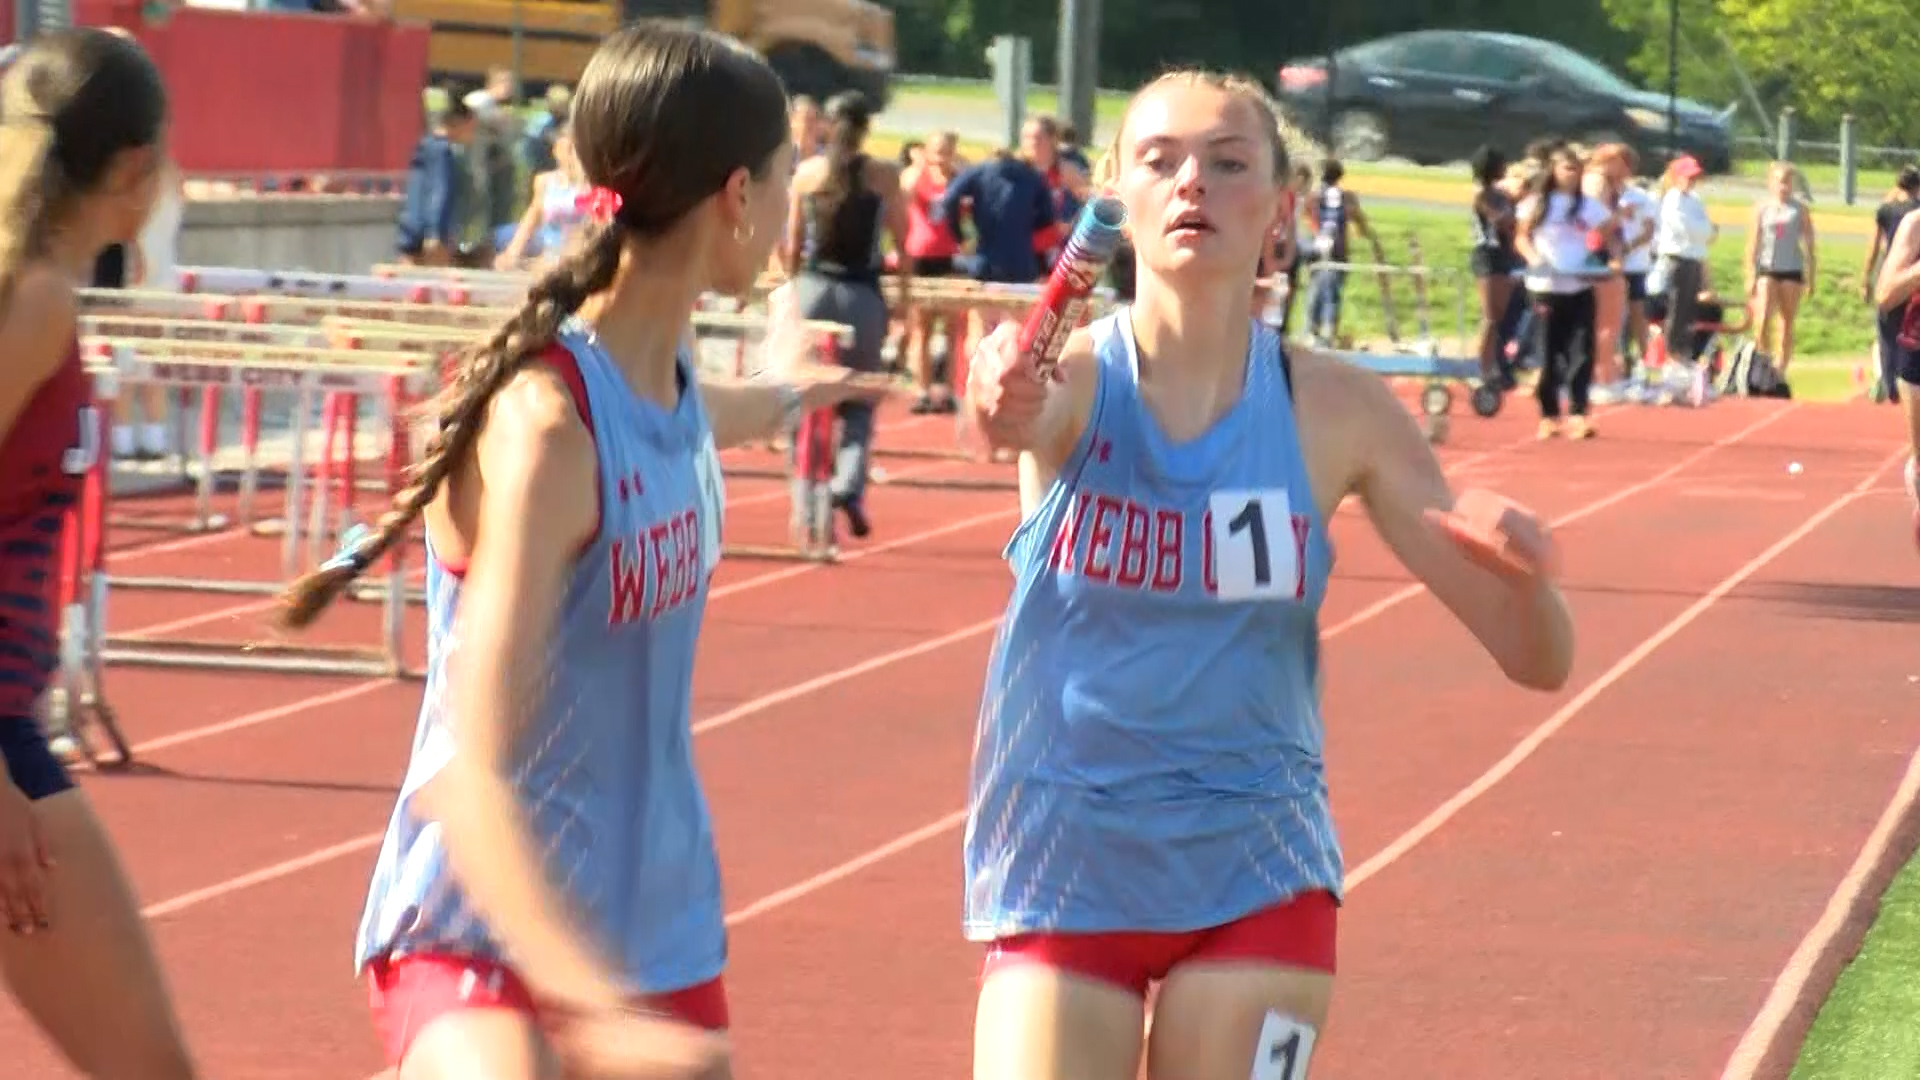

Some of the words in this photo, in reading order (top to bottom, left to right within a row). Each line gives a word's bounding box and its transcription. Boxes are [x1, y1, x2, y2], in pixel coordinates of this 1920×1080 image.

[608, 509, 699, 625] WEBB
[1228, 499, 1272, 588] 1
[1269, 1031, 1301, 1080] 1
